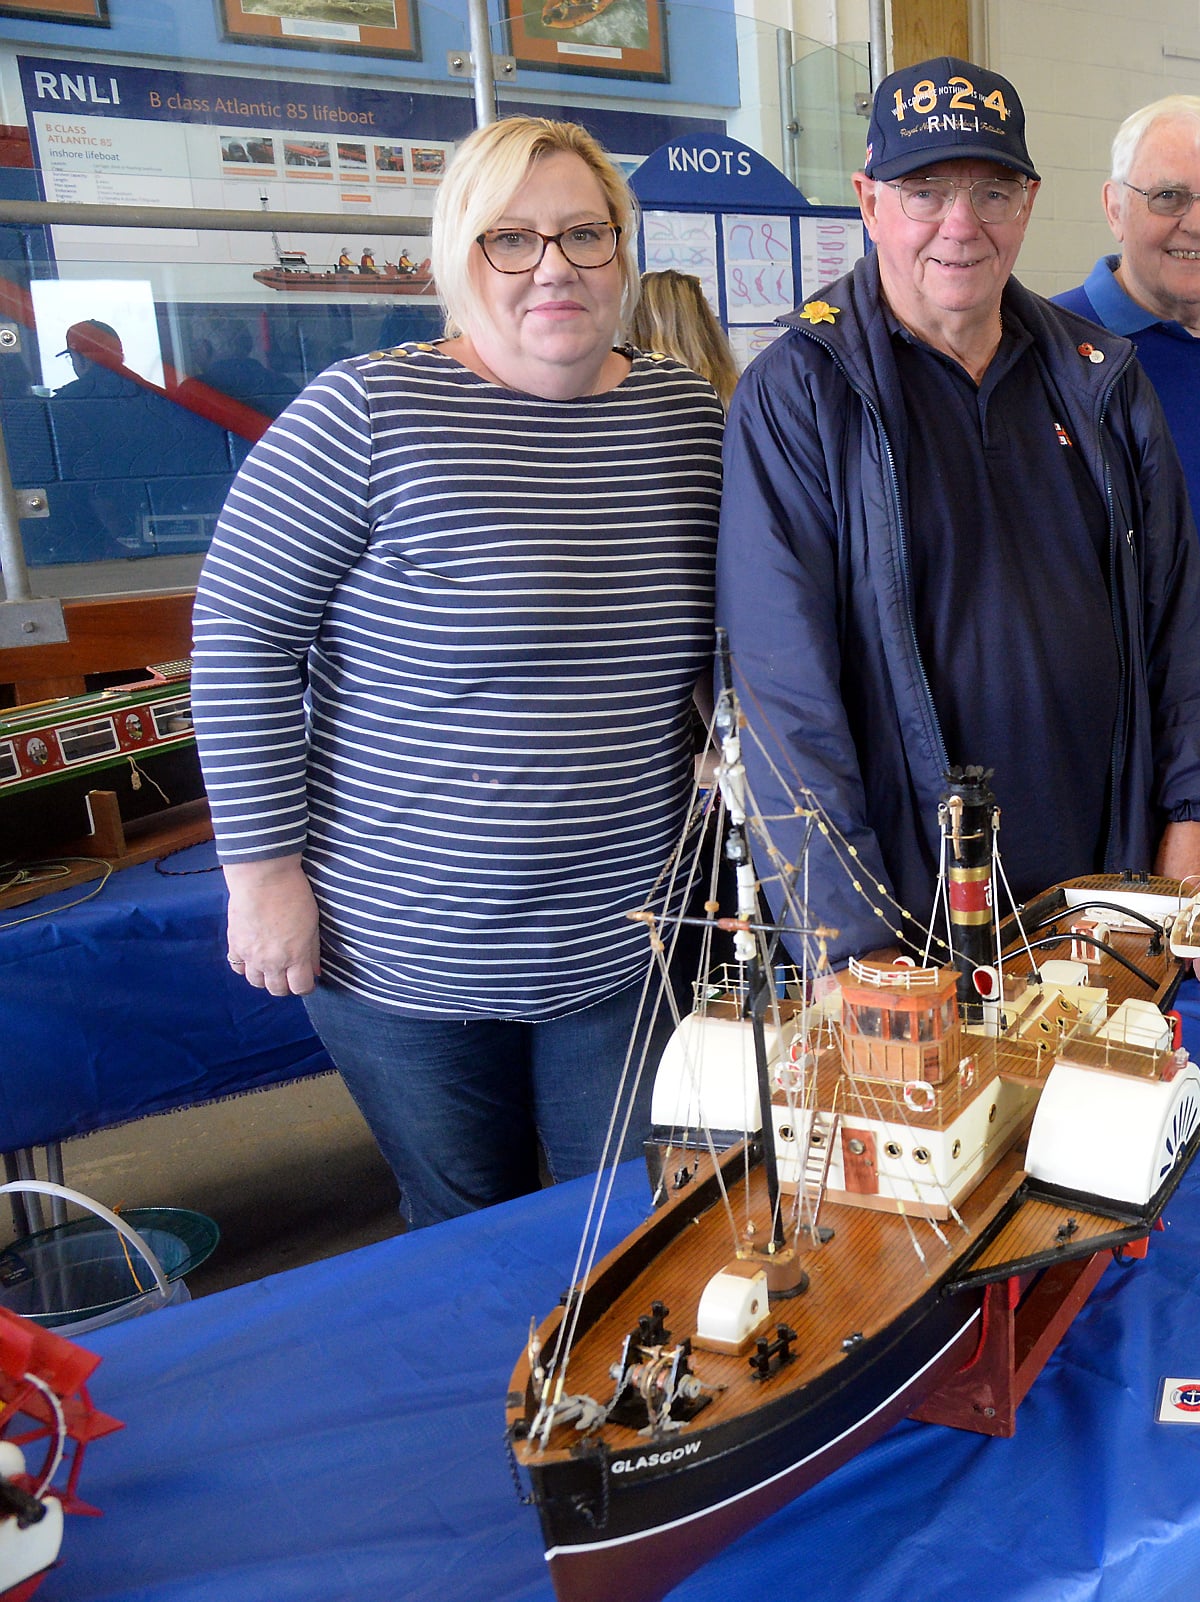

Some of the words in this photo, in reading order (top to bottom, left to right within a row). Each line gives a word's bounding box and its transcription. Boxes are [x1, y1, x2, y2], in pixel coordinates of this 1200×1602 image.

[34, 71, 120, 105] RNLI
[893, 76, 1007, 121] 1824
[149, 91, 161, 108] B
[167, 93, 210, 112] class
[215, 97, 281, 118] Atlantic
[286, 103, 308, 120] 85
[313, 105, 375, 125] lifeboat
[46, 124, 53, 132] B
[54, 124, 87, 134] CLASS
[927, 113, 979, 133] RNLI
[48, 135, 98, 146] ATLANTIC
[99, 138, 112, 147] 85
[49, 148, 83, 159] inshore
[85, 150, 120, 161] lifeboat
[668, 147, 752, 176] KNOTS
[611, 1441, 702, 1473] GLASGOW
